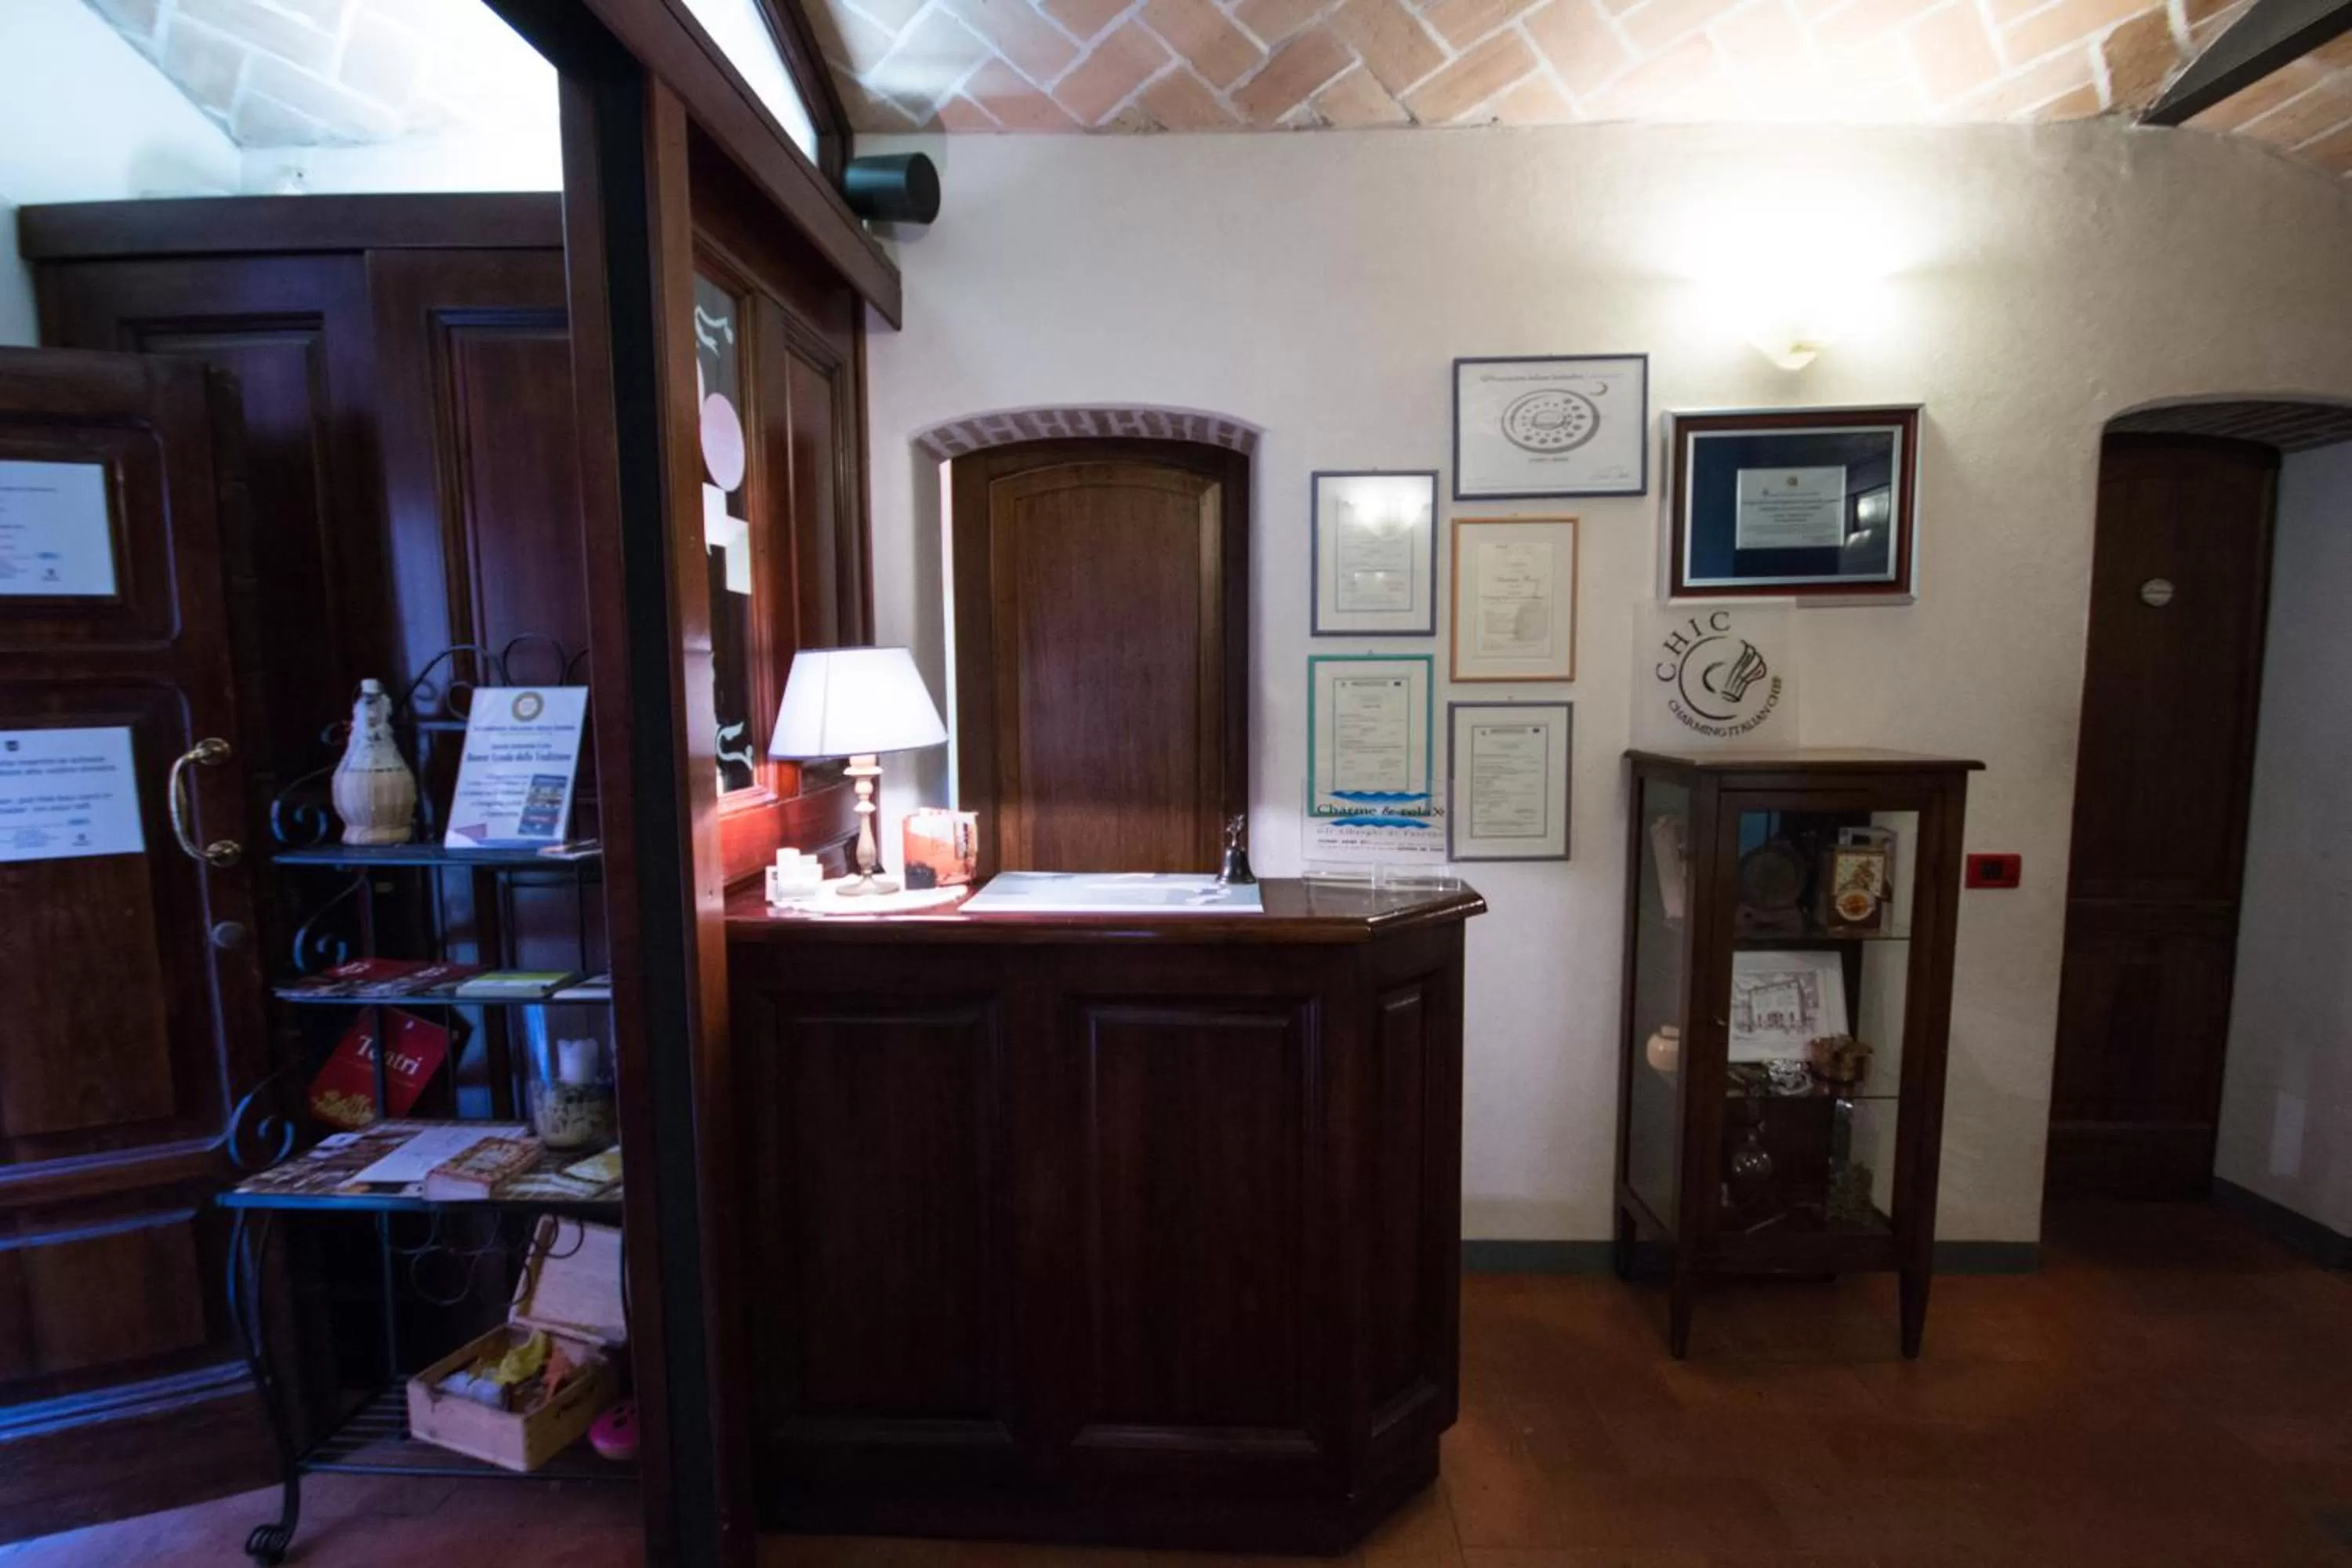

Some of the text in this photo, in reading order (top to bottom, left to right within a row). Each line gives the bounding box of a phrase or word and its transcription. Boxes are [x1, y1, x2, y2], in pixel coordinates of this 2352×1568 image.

[1656, 611, 1731, 682] CHIC
[1668, 699, 1727, 737] CHARMING
[1728, 707, 1772, 737] ITALIAN
